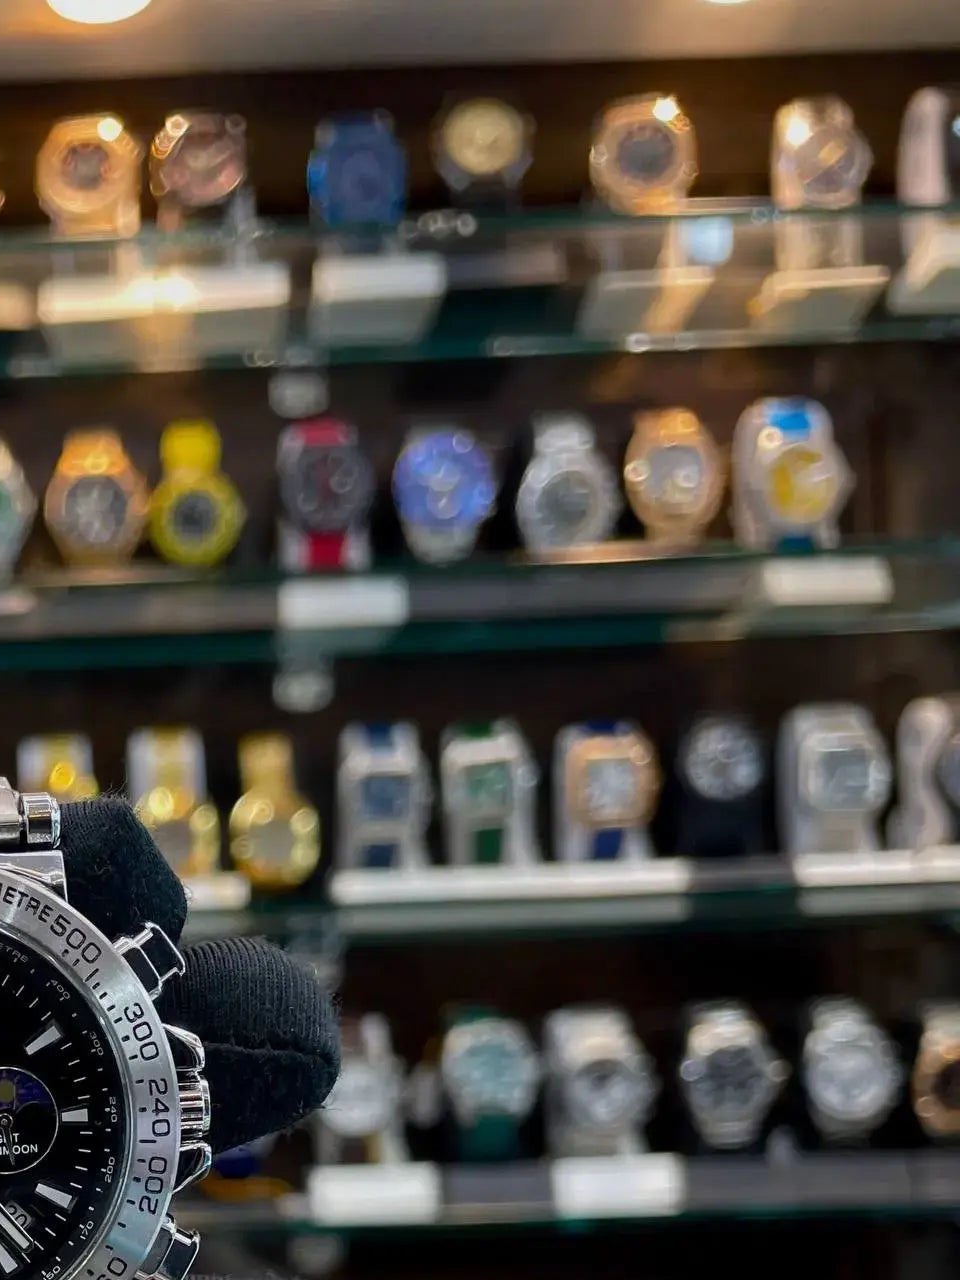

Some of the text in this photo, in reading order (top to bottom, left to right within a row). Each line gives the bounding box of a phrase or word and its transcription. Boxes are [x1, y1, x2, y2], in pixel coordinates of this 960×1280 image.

[49, 913, 103, 965] 500
[50, 978, 70, 1000] 400
[90, 1032, 104, 1056] 300
[124, 1002, 160, 1062] 300
[109, 1096, 118, 1122] 240
[148, 1078, 171, 1138] 240
[104, 1156, 116, 1184] 200
[138, 1156, 168, 1216] 200
[80, 1220, 94, 1240] 170
